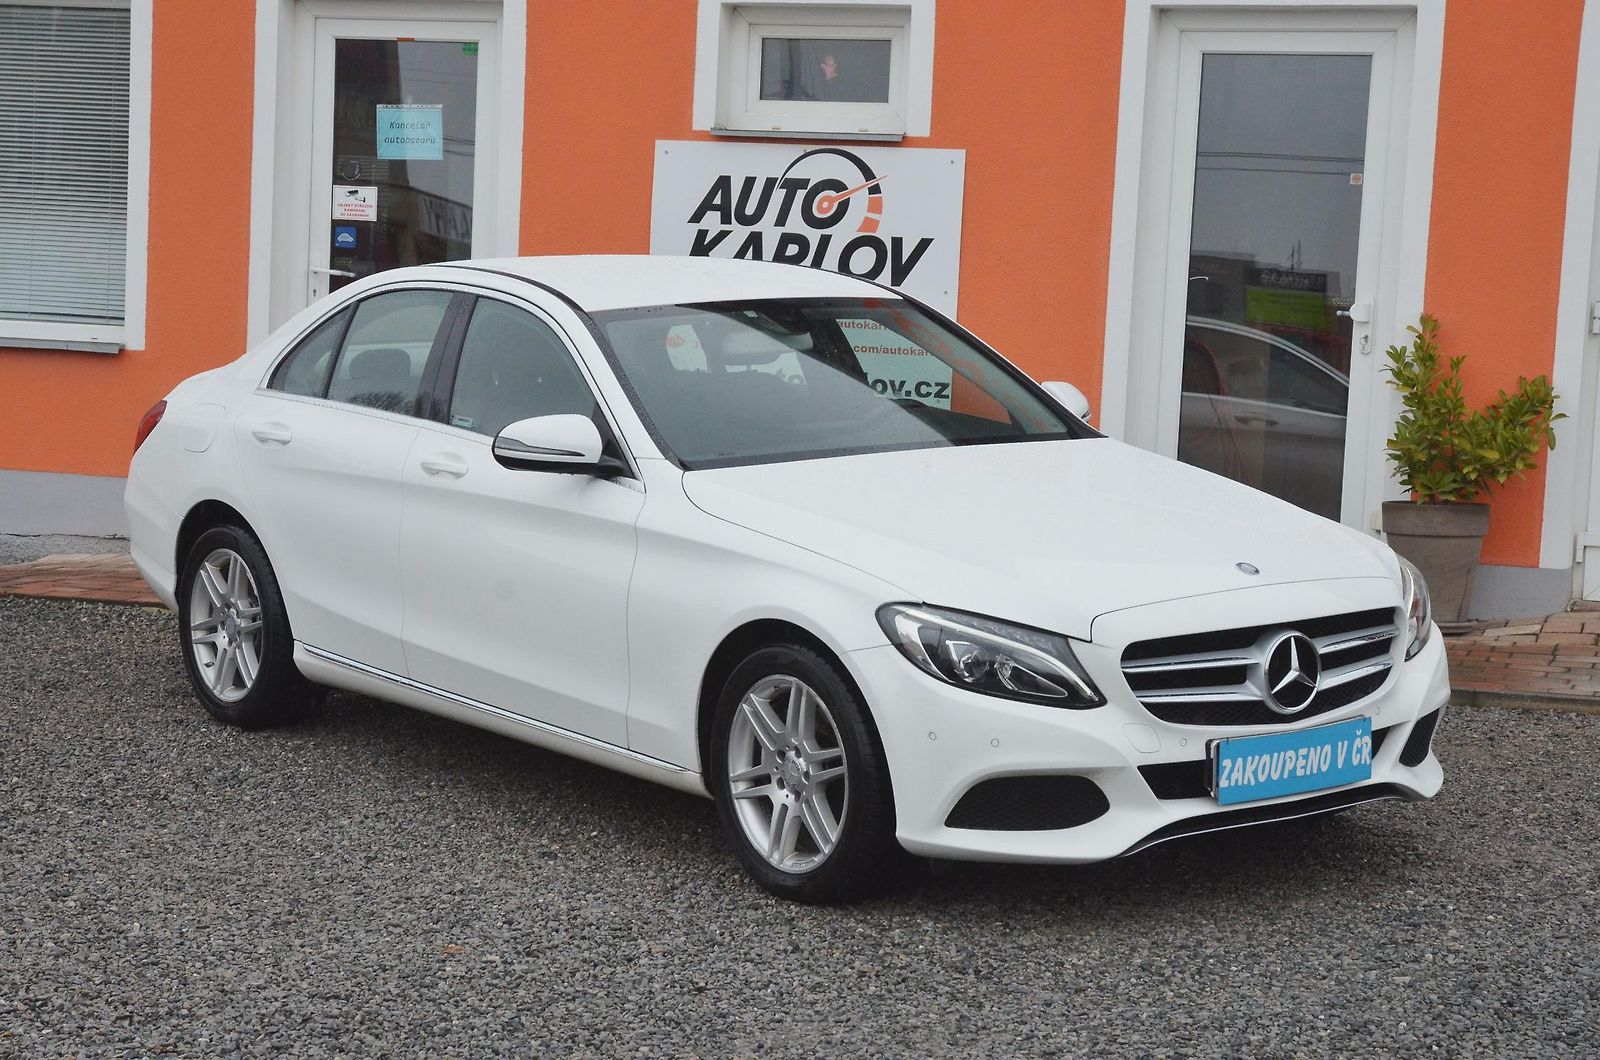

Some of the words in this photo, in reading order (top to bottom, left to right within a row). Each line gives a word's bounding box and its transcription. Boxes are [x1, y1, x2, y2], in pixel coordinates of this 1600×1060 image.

[384, 135, 436, 144] autobazaru
[687, 175, 851, 229] AUTO
[839, 321, 887, 331] autokar
[1219, 743, 1332, 788] ZAKOUPENO
[1337, 740, 1348, 769] V
[1352, 729, 1372, 766] ČR
